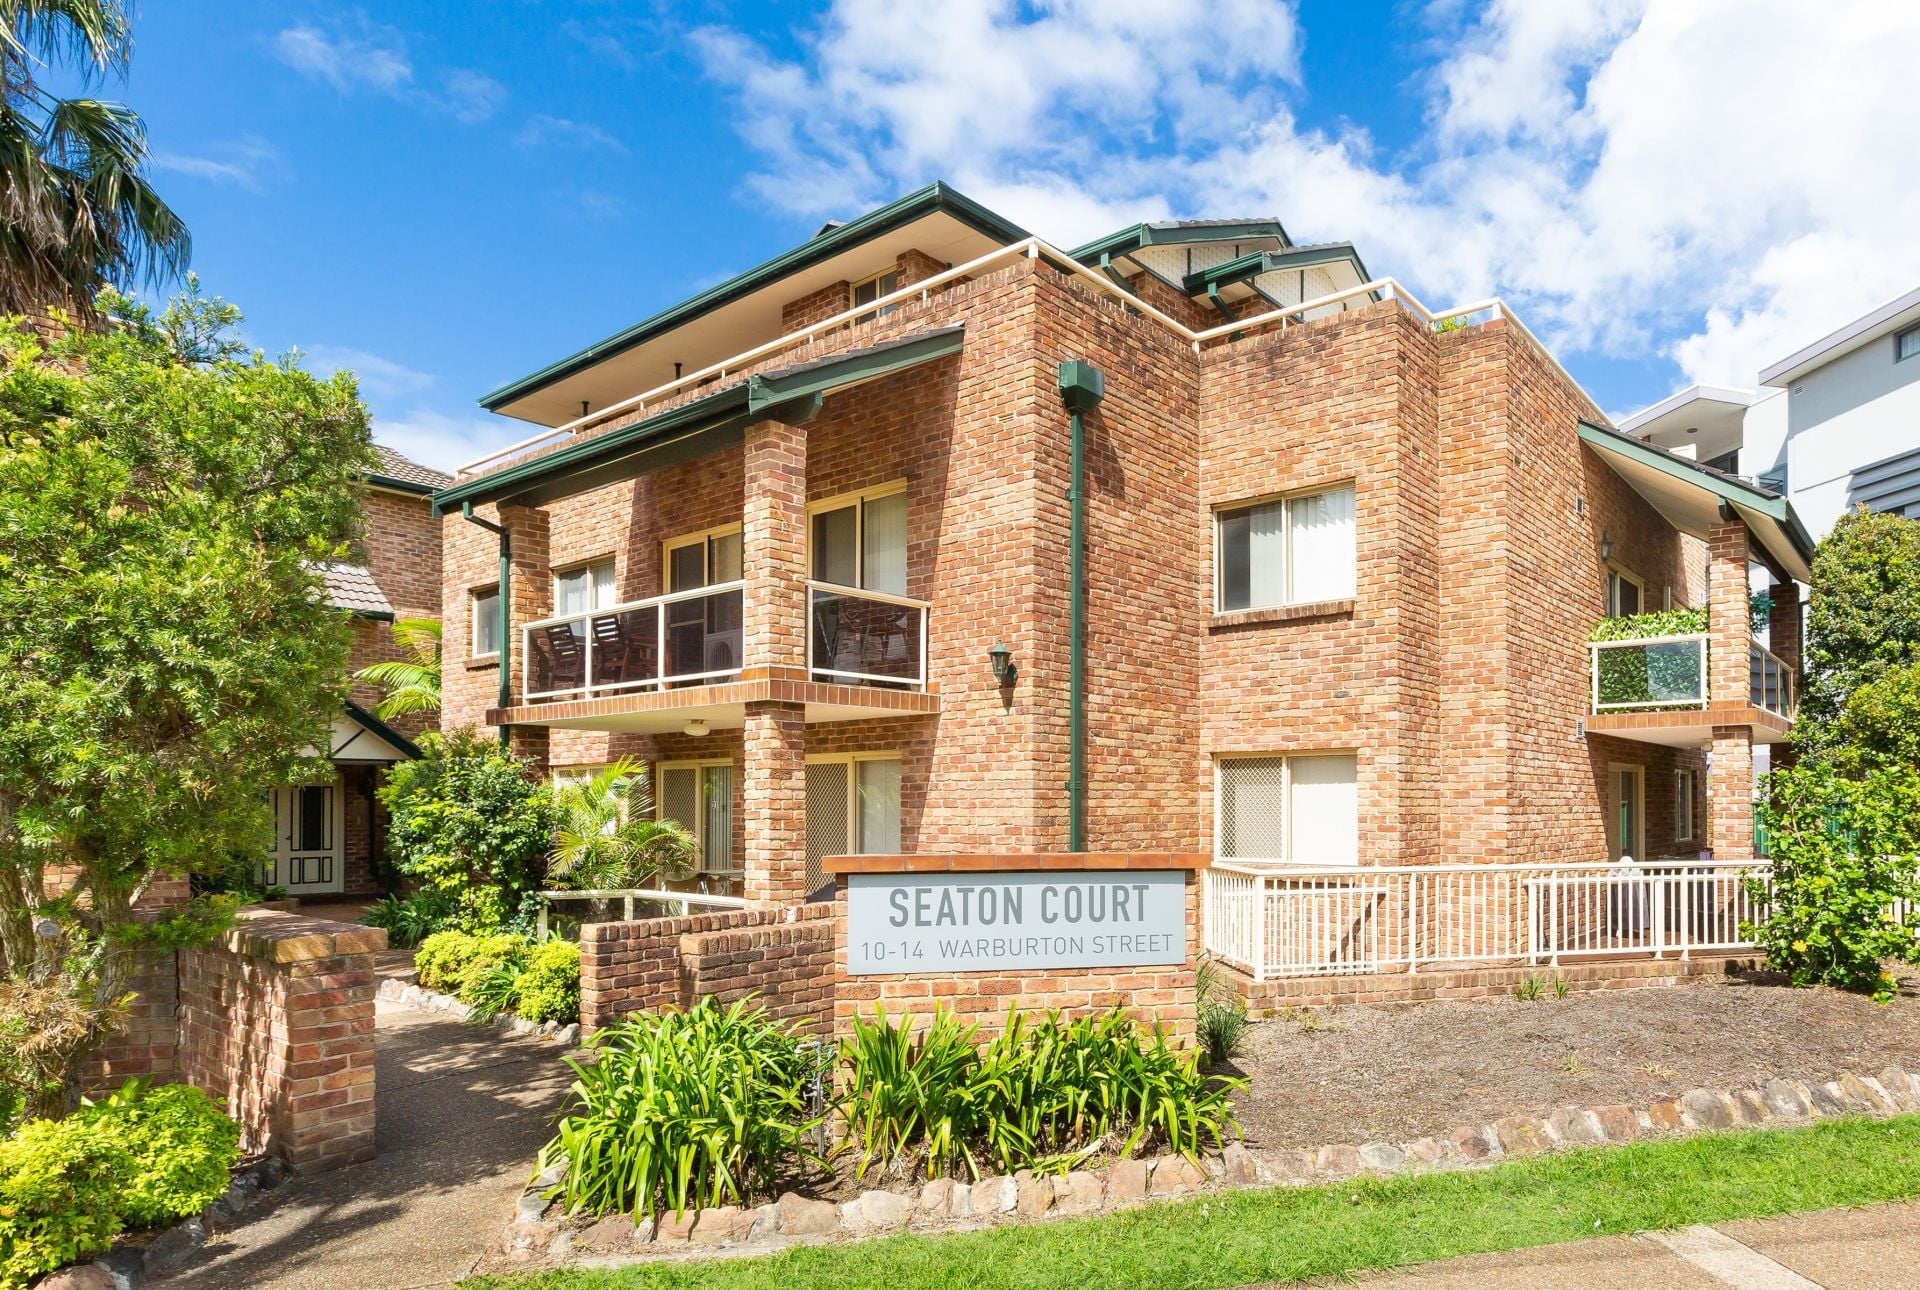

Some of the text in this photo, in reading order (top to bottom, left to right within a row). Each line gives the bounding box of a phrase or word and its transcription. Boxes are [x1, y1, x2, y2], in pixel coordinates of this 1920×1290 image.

[889, 884, 1149, 927] SEATON COURT
[861, 933, 1173, 961] 10-14 WARBURTON STREET
